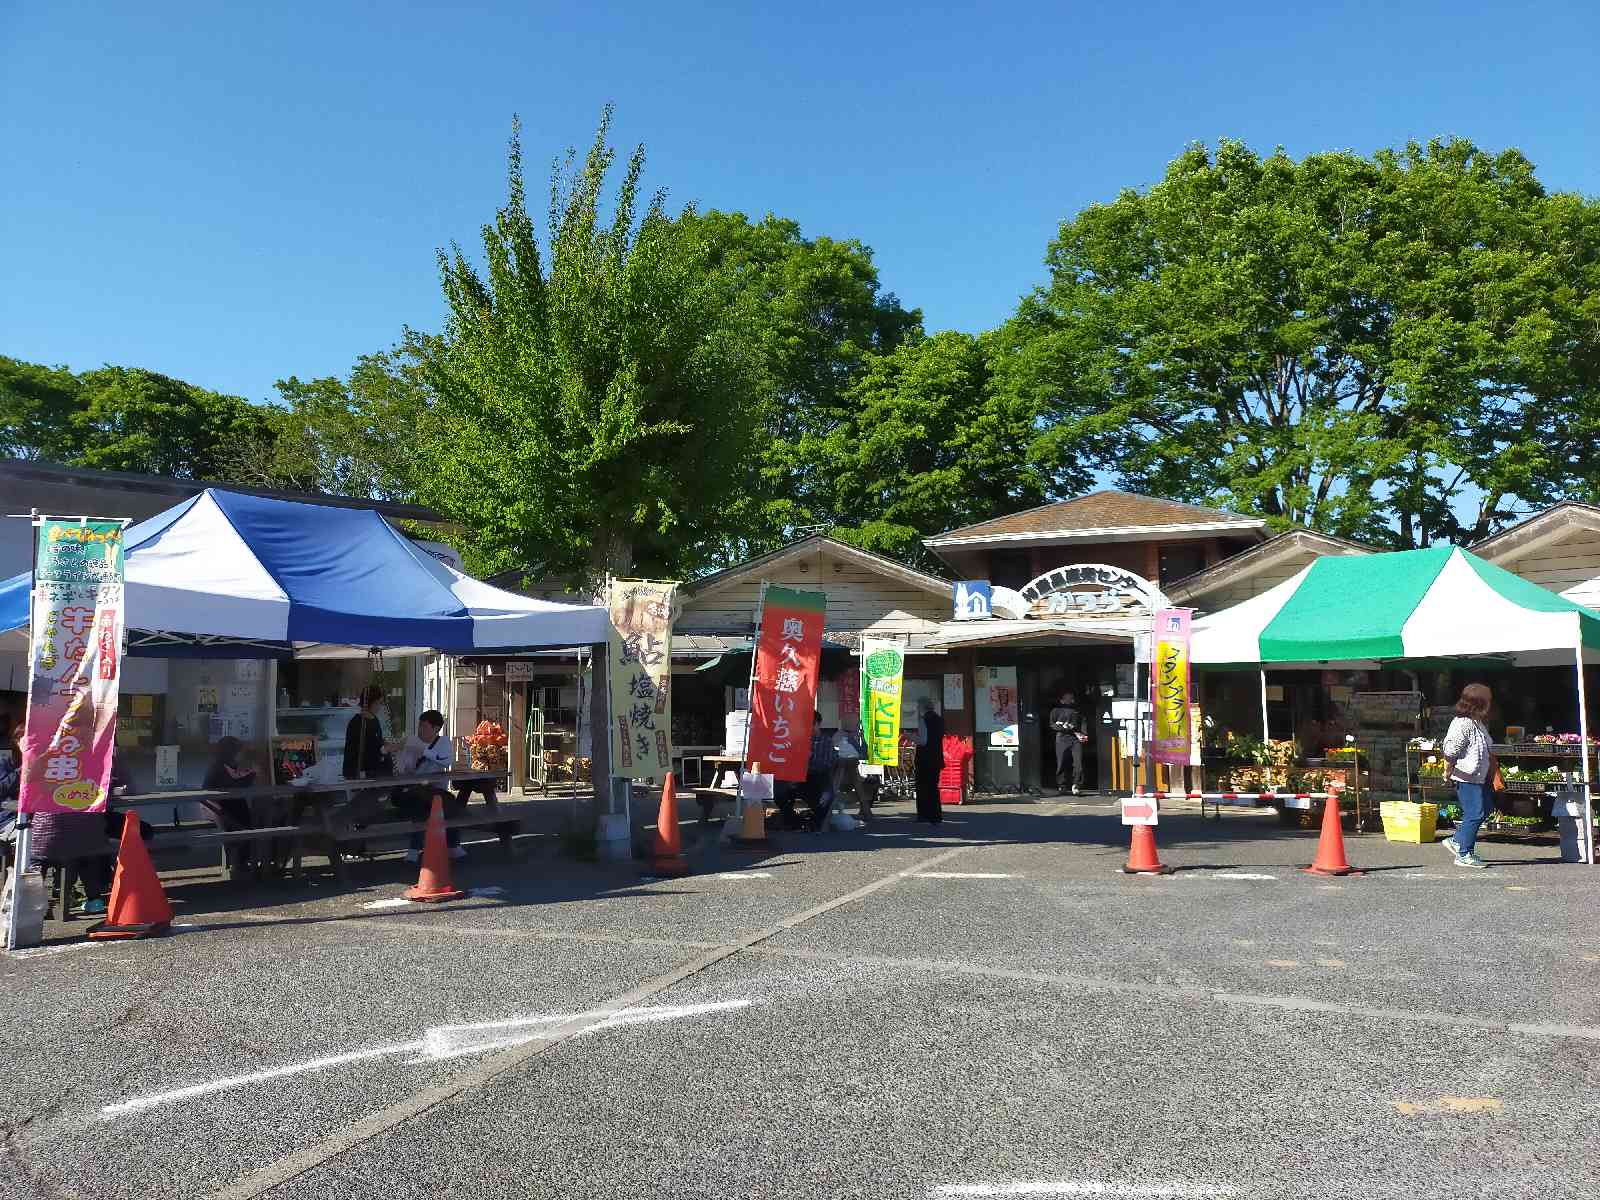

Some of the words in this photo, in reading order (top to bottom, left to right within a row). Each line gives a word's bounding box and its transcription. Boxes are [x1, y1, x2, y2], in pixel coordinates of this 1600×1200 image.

[768, 617, 805, 764] 奥久慈いちご
[1159, 647, 1186, 737] スタンプラリー
